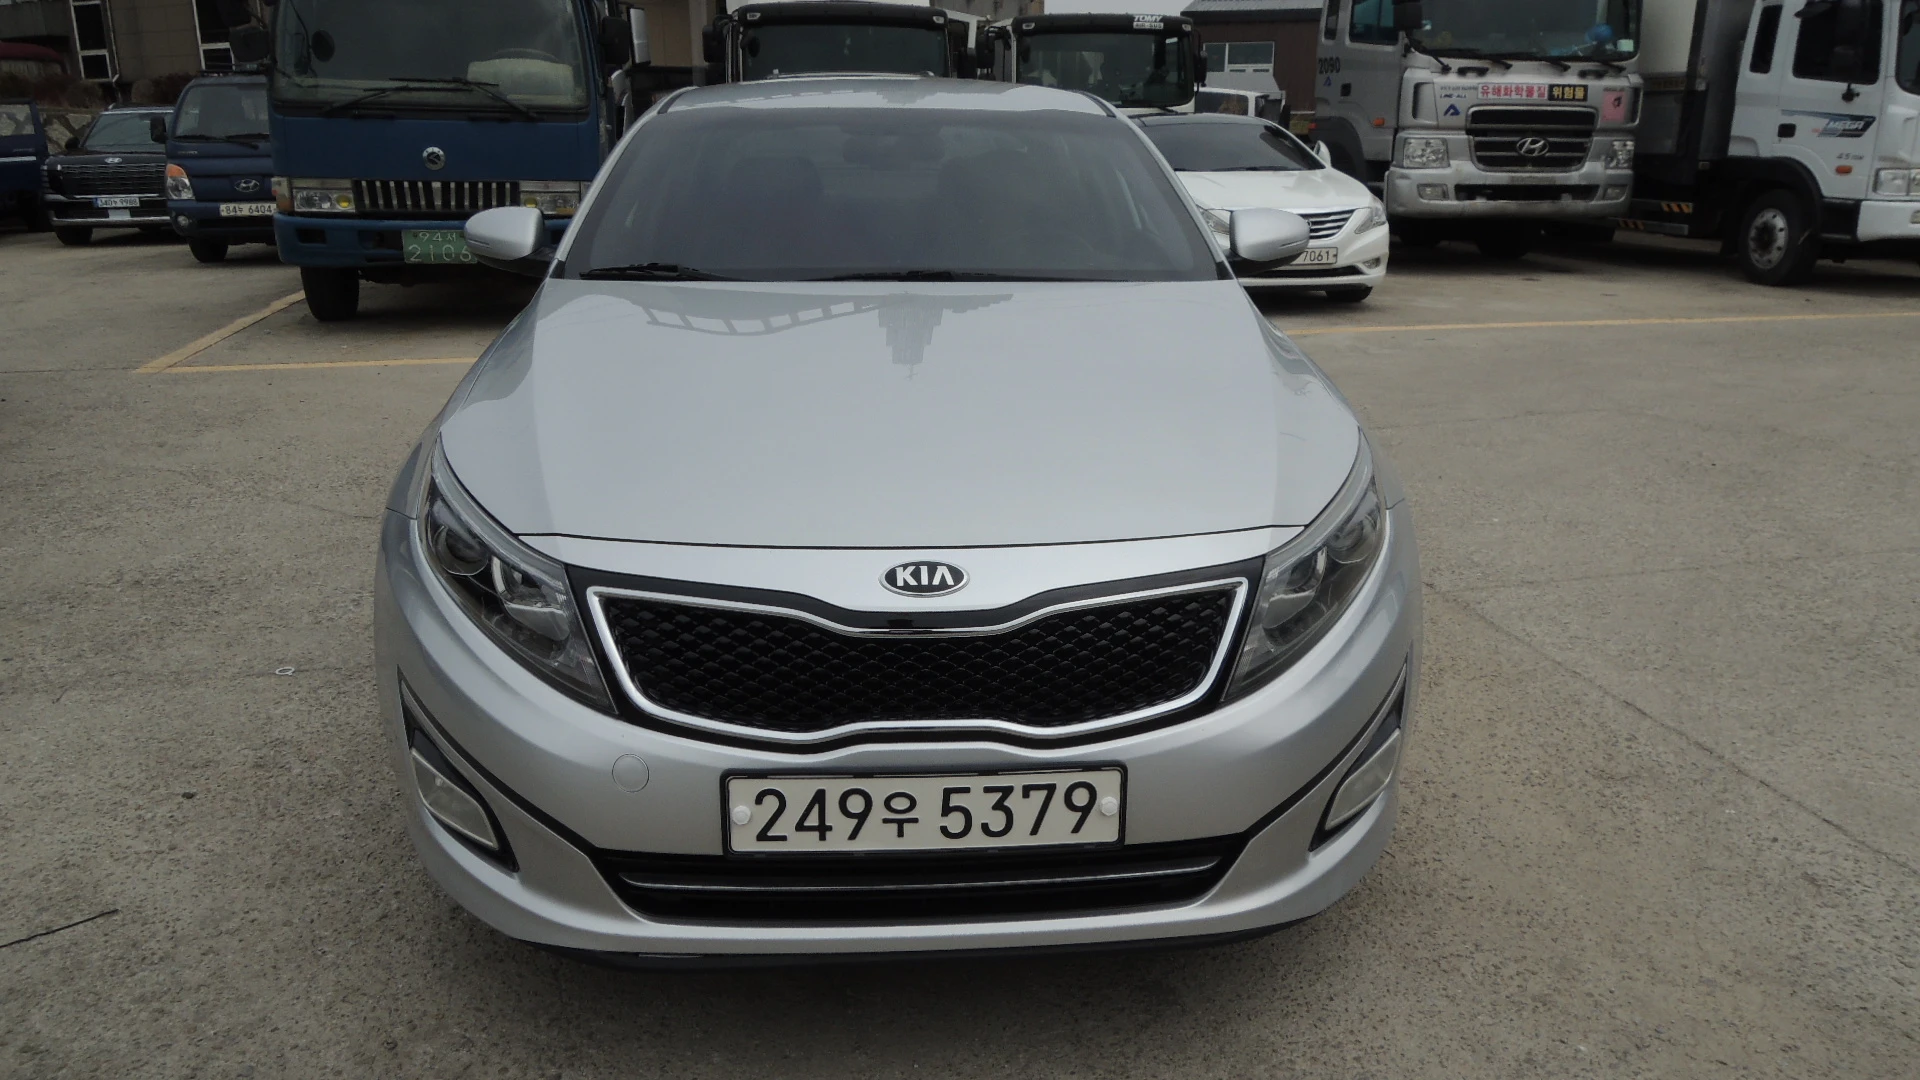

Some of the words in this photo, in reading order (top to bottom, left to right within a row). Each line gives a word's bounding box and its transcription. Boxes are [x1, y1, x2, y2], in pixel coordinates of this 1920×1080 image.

[1134, 14, 1163, 22] TOMY
[1318, 56, 1341, 74] 2090
[1481, 84, 1547, 99] 유해화학물질
[1552, 86, 1585, 99] 위험물
[1826, 120, 1865, 130] MEGA
[248, 204, 273, 214] 6404
[408, 244, 472, 262] 2106
[1302, 250, 1330, 262] 7061
[894, 565, 955, 587] KIA
[754, 787, 919, 842] 249우
[939, 780, 1098, 840] 5379
